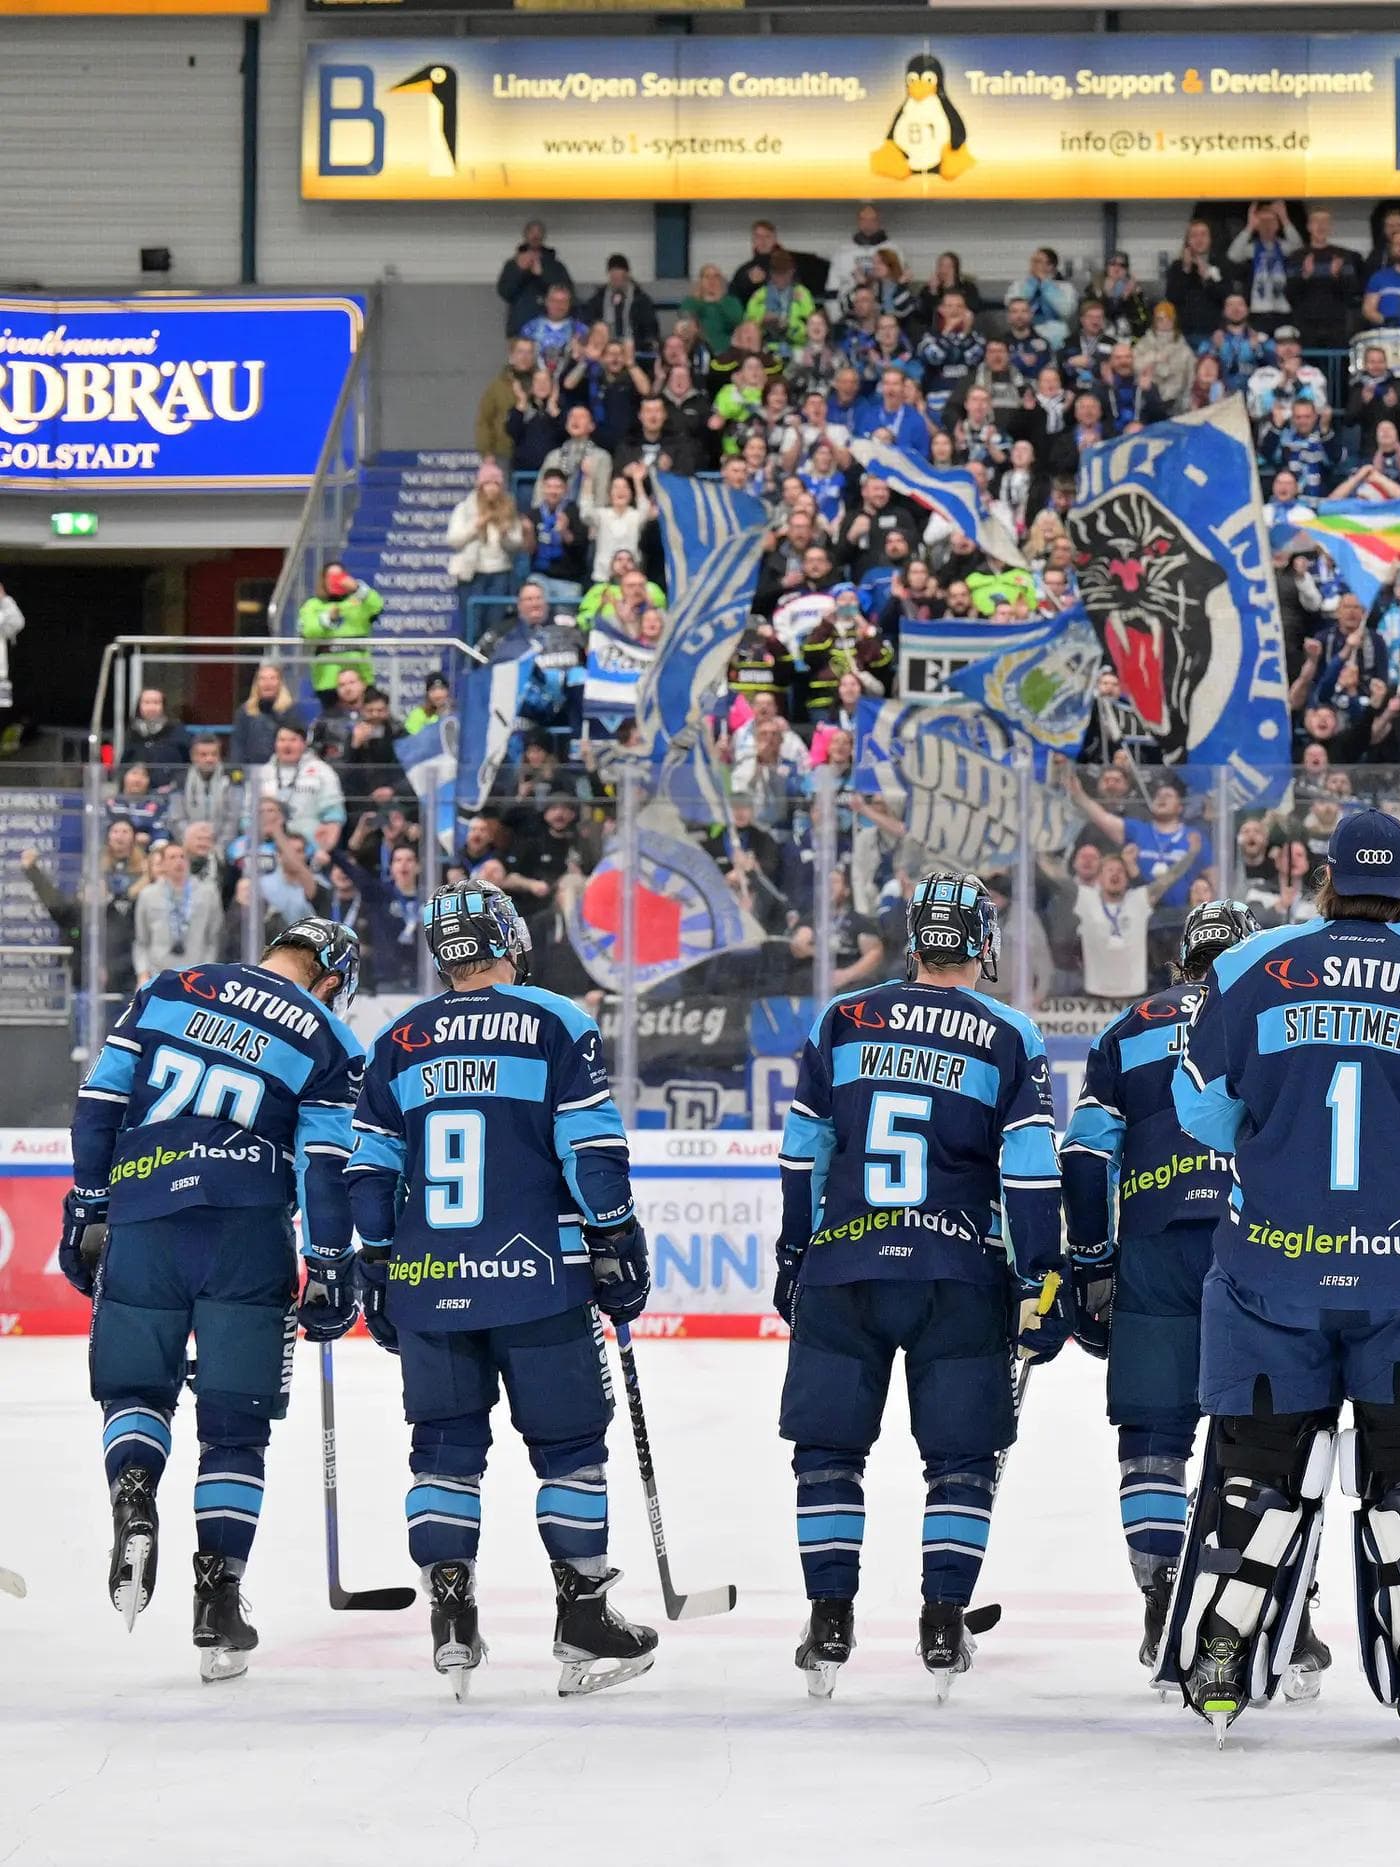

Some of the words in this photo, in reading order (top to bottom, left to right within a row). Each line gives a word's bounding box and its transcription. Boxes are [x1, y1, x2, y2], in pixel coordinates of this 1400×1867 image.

[494, 73, 636, 102] Linux/Open
[642, 73, 723, 98] Source
[729, 72, 866, 101] Consulting,
[965, 70, 1072, 101] Training,
[1078, 69, 1174, 101] Support
[1182, 69, 1203, 94] &
[1210, 67, 1373, 97] Development
[544, 134, 783, 157] www.b1-systems.de
[1059, 129, 1310, 156] info@b1-systems.de
[218, 980, 320, 1040] SATURN
[434, 1012, 540, 1045] SATURN
[889, 1003, 997, 1050] SATURN
[183, 1009, 271, 1065] QUAAS
[422, 1059, 498, 1097] STORM
[859, 1043, 966, 1091] WAGNER
[863, 1091, 933, 1208] 5
[1326, 1061, 1363, 1191] 1
[424, 1109, 486, 1230] 9
